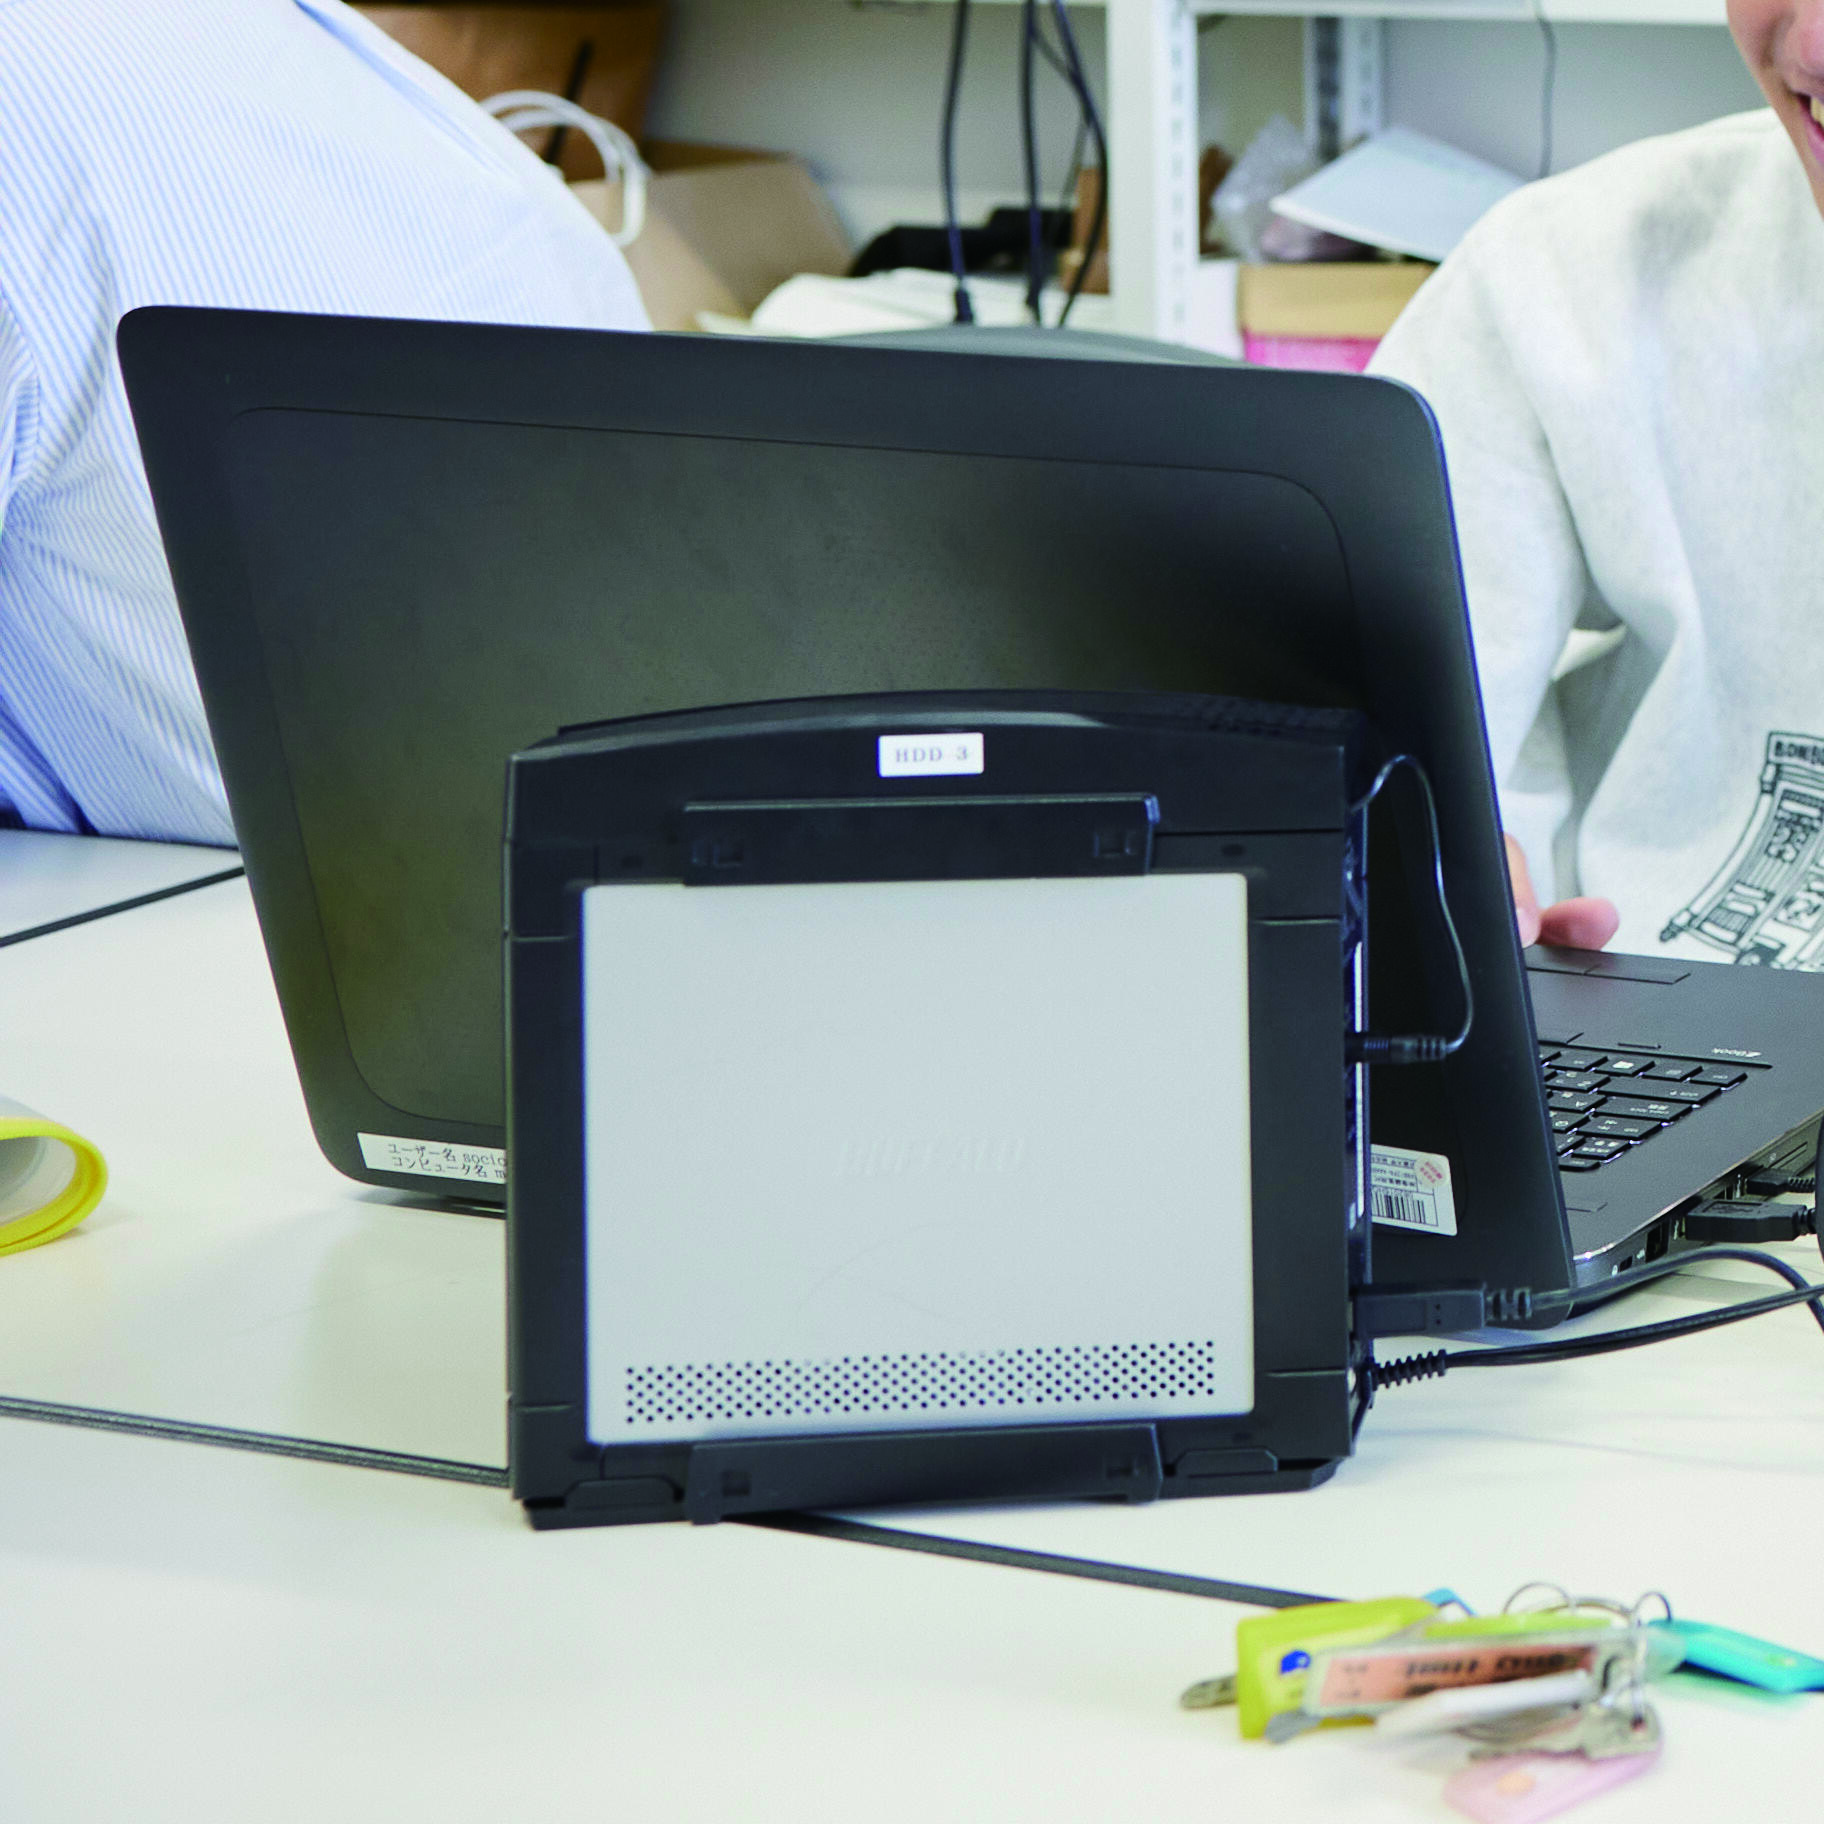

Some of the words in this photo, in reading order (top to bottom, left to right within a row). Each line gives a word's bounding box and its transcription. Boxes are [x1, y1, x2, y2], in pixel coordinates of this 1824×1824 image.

[896, 746, 943, 763] HDD
[388, 1143, 457, 1163] ユーザー名
